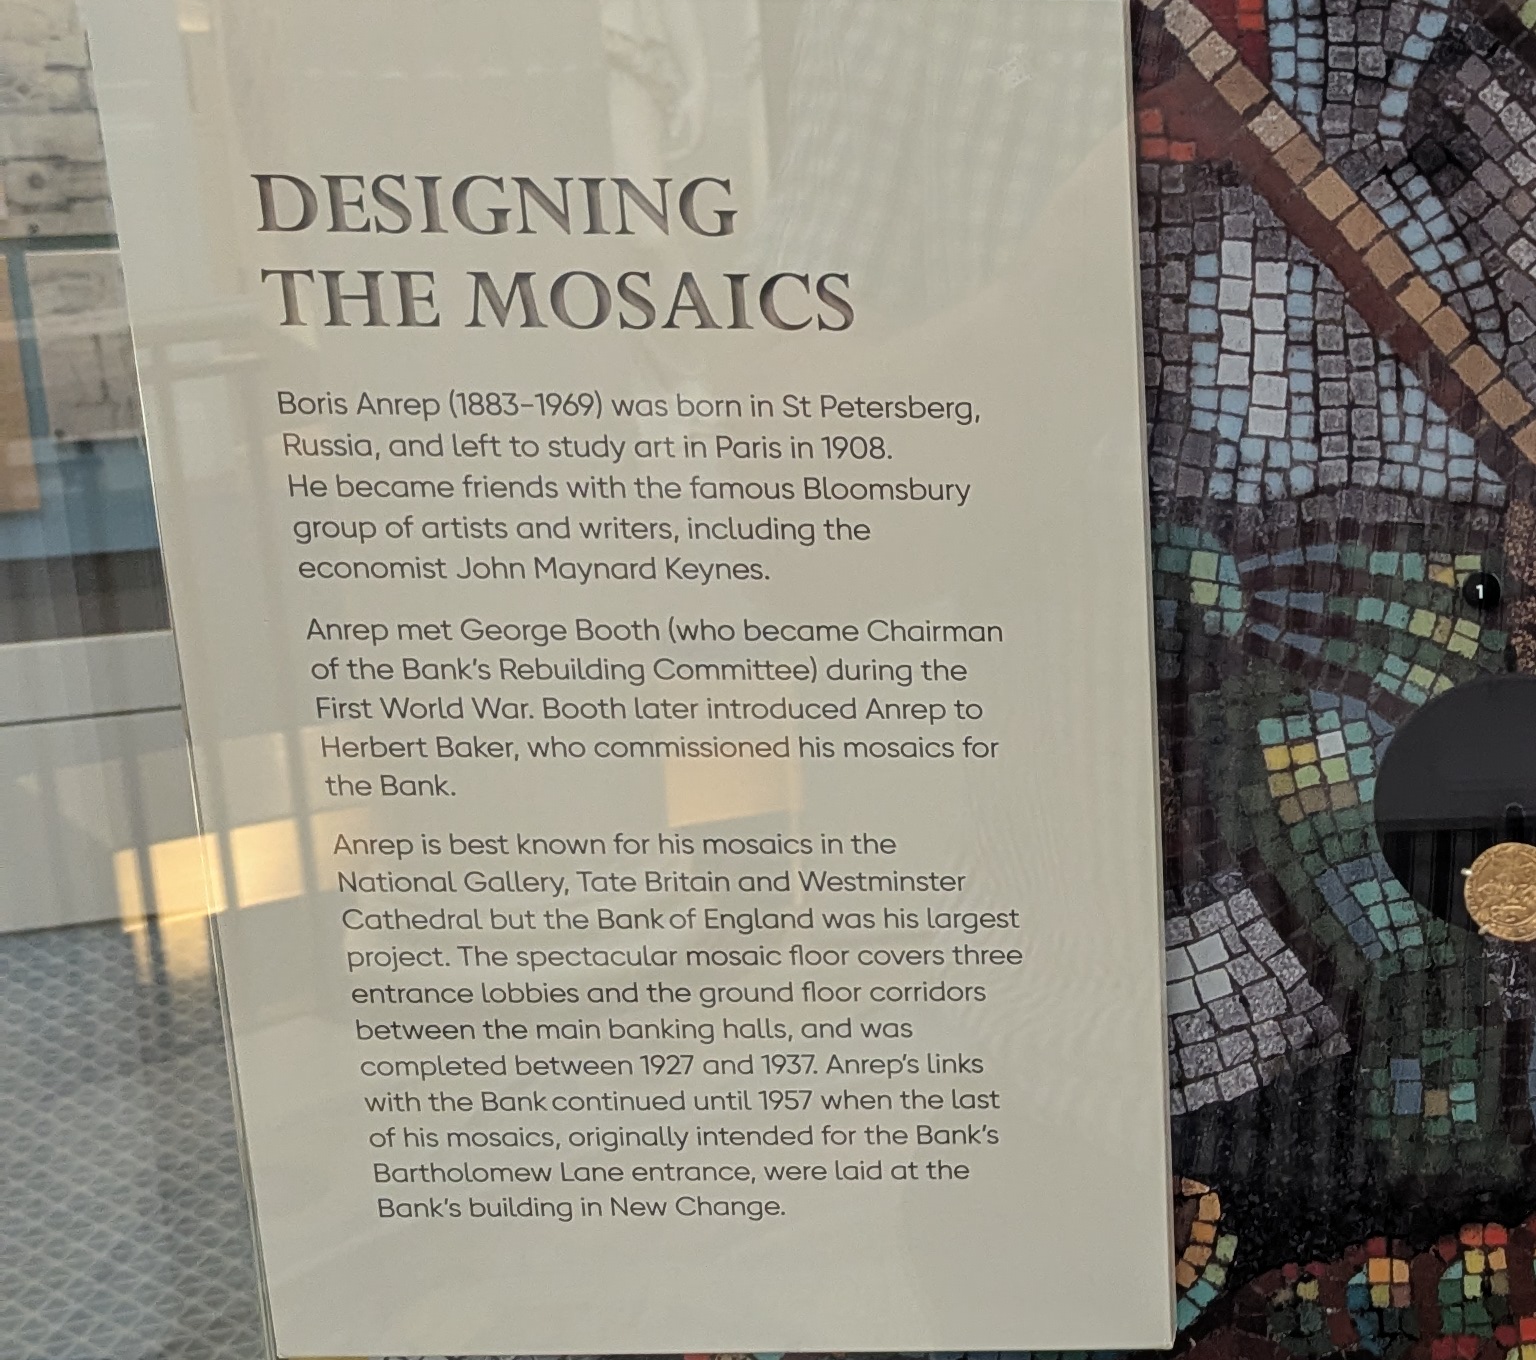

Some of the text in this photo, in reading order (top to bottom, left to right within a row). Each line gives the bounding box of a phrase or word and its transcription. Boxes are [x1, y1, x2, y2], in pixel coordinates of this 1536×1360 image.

[249, 172, 740, 239] DESIGNING
[259, 267, 856, 333] THE MOSAICS
[276, 389, 350, 417] Boris
[355, 390, 442, 423] Anrep
[609, 398, 670, 419] was
[675, 391, 743, 419] born
[748, 392, 775, 419] in
[781, 392, 813, 419] St
[819, 393, 981, 427] Petersberg,
[281, 431, 894, 466] Russia, and left to study art in Paris in 1908.
[286, 472, 972, 508] He became friends with the famous Bloomsbury
[292, 513, 872, 548] group of artists and writers, including the
[297, 554, 771, 587] economist John Maynard Keynes.
[1475, 583, 1485, 600] 1
[305, 614, 1004, 649] Anrep met George Booth (who became Chairman
[309, 654, 969, 689] of the Bank's Rebuilding Committee) during the
[314, 695, 984, 727] First World War. Booth later introduced Anrep to
[319, 734, 1001, 763] Herbert Baker, who commissioned his mosaics for
[323, 772, 458, 798] the Bank.
[332, 831, 898, 862] Anrep is best known for his mosaics in the
[336, 869, 968, 899] National Gallery, Tate Britain and Westminster
[340, 905, 1022, 937] Cathedral but the Bank of England was his largest
[346, 942, 1024, 974] project. The spectacular mosaic floor covers three
[350, 979, 988, 1010] entrance lobbies and the ground floor corridors
[354, 1015, 915, 1046] between the main banking halls, and was
[359, 1051, 985, 1083] completed between 1927 and 1937. Anrep's links
[362, 1087, 1002, 1114] with the Bank continued until 1957 when the last
[368, 1122, 1001, 1154] of his mosaics, originally intended for the Bank's
[372, 1158, 971, 1186] Bartholomew Lane entrance, were laid at the
[376, 1194, 787, 1224] Bank's building in New Change.
